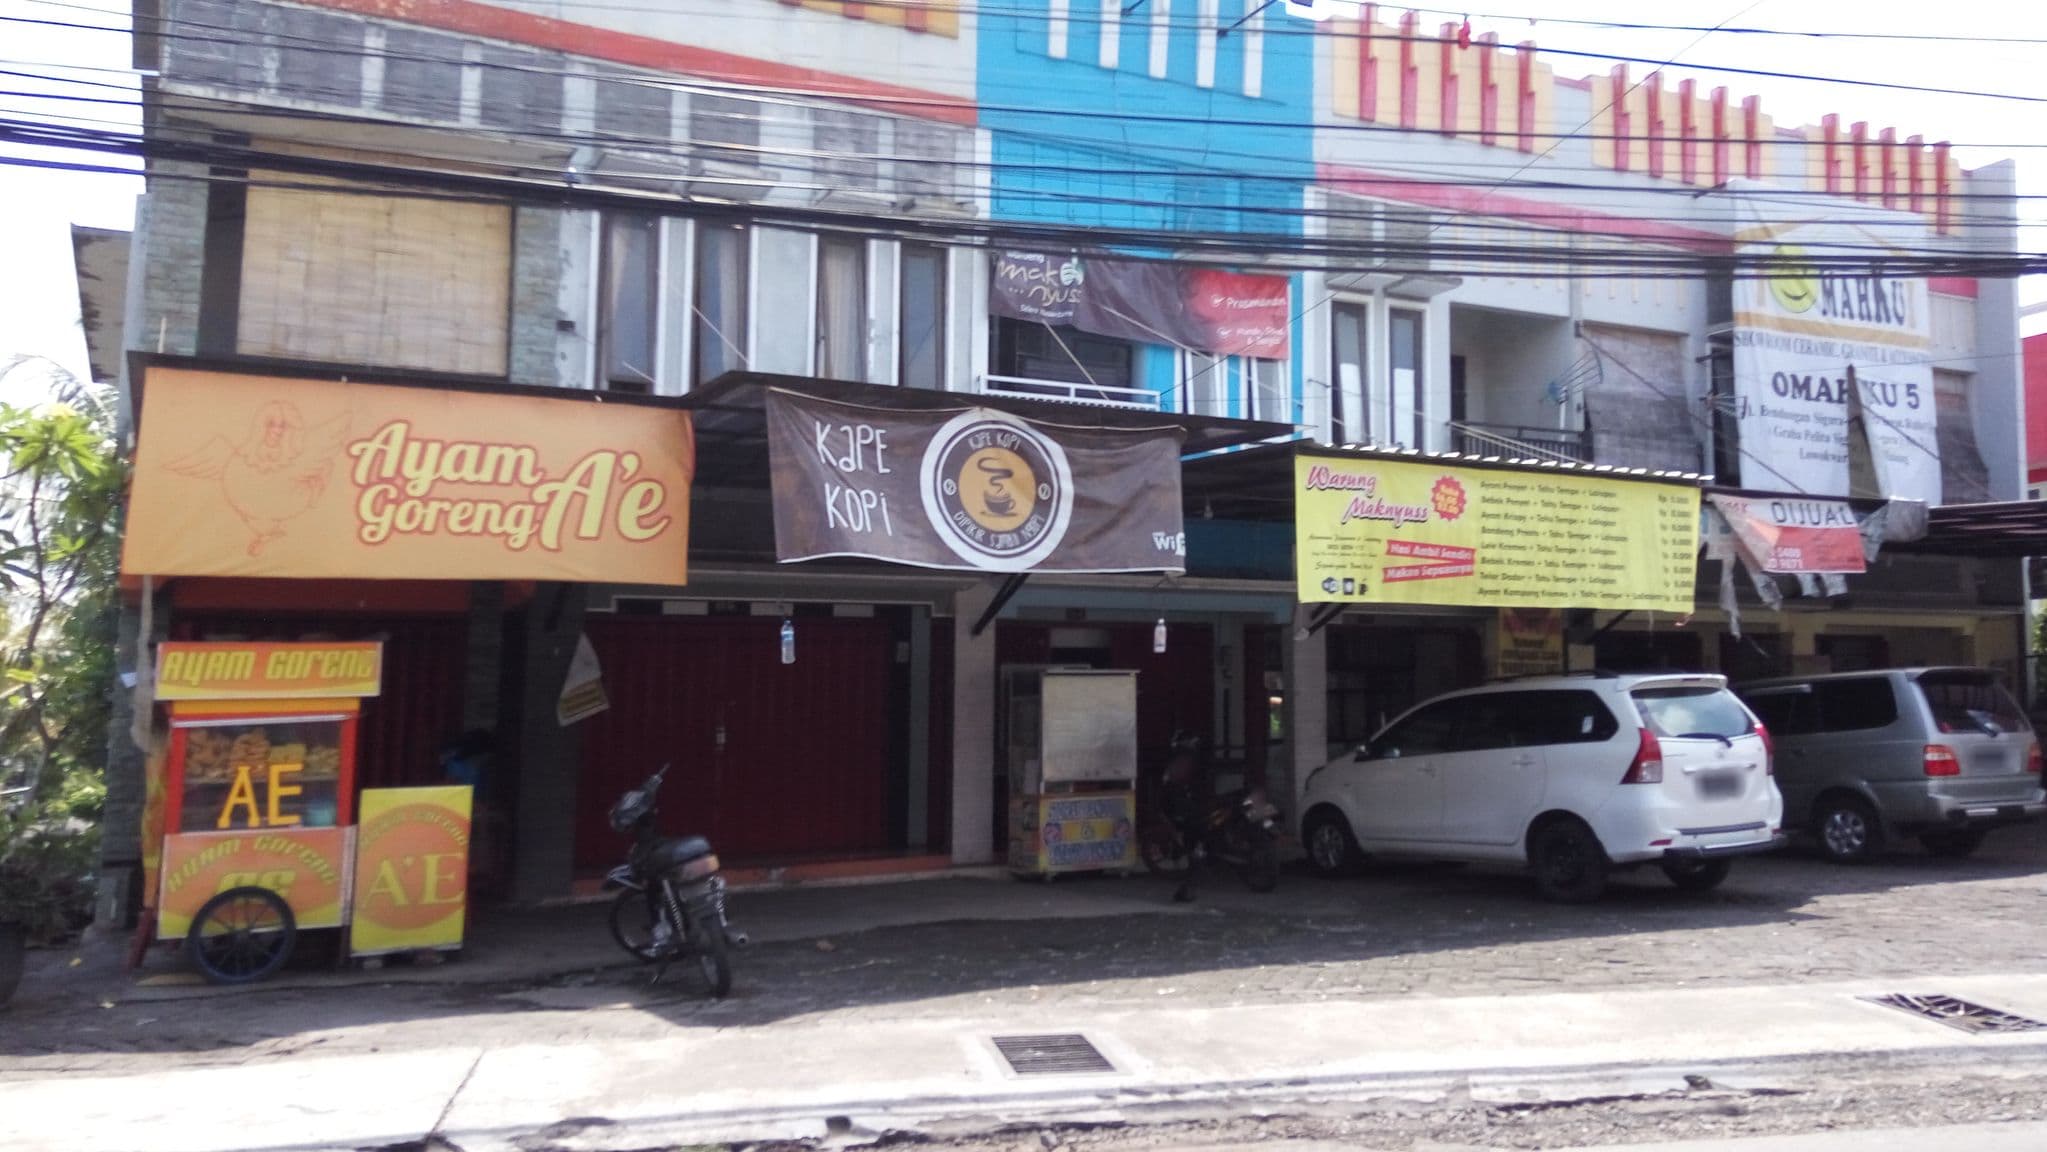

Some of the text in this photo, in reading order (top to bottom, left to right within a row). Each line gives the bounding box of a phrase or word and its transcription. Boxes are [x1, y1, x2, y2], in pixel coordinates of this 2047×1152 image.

[1906, 383, 1920, 409] 5
[349, 419, 543, 495] Ayam
[1307, 466, 1376, 498] Warung
[358, 484, 538, 548] Goreng
[1341, 497, 1428, 528] Maknyuss
[216, 763, 304, 828] AE
